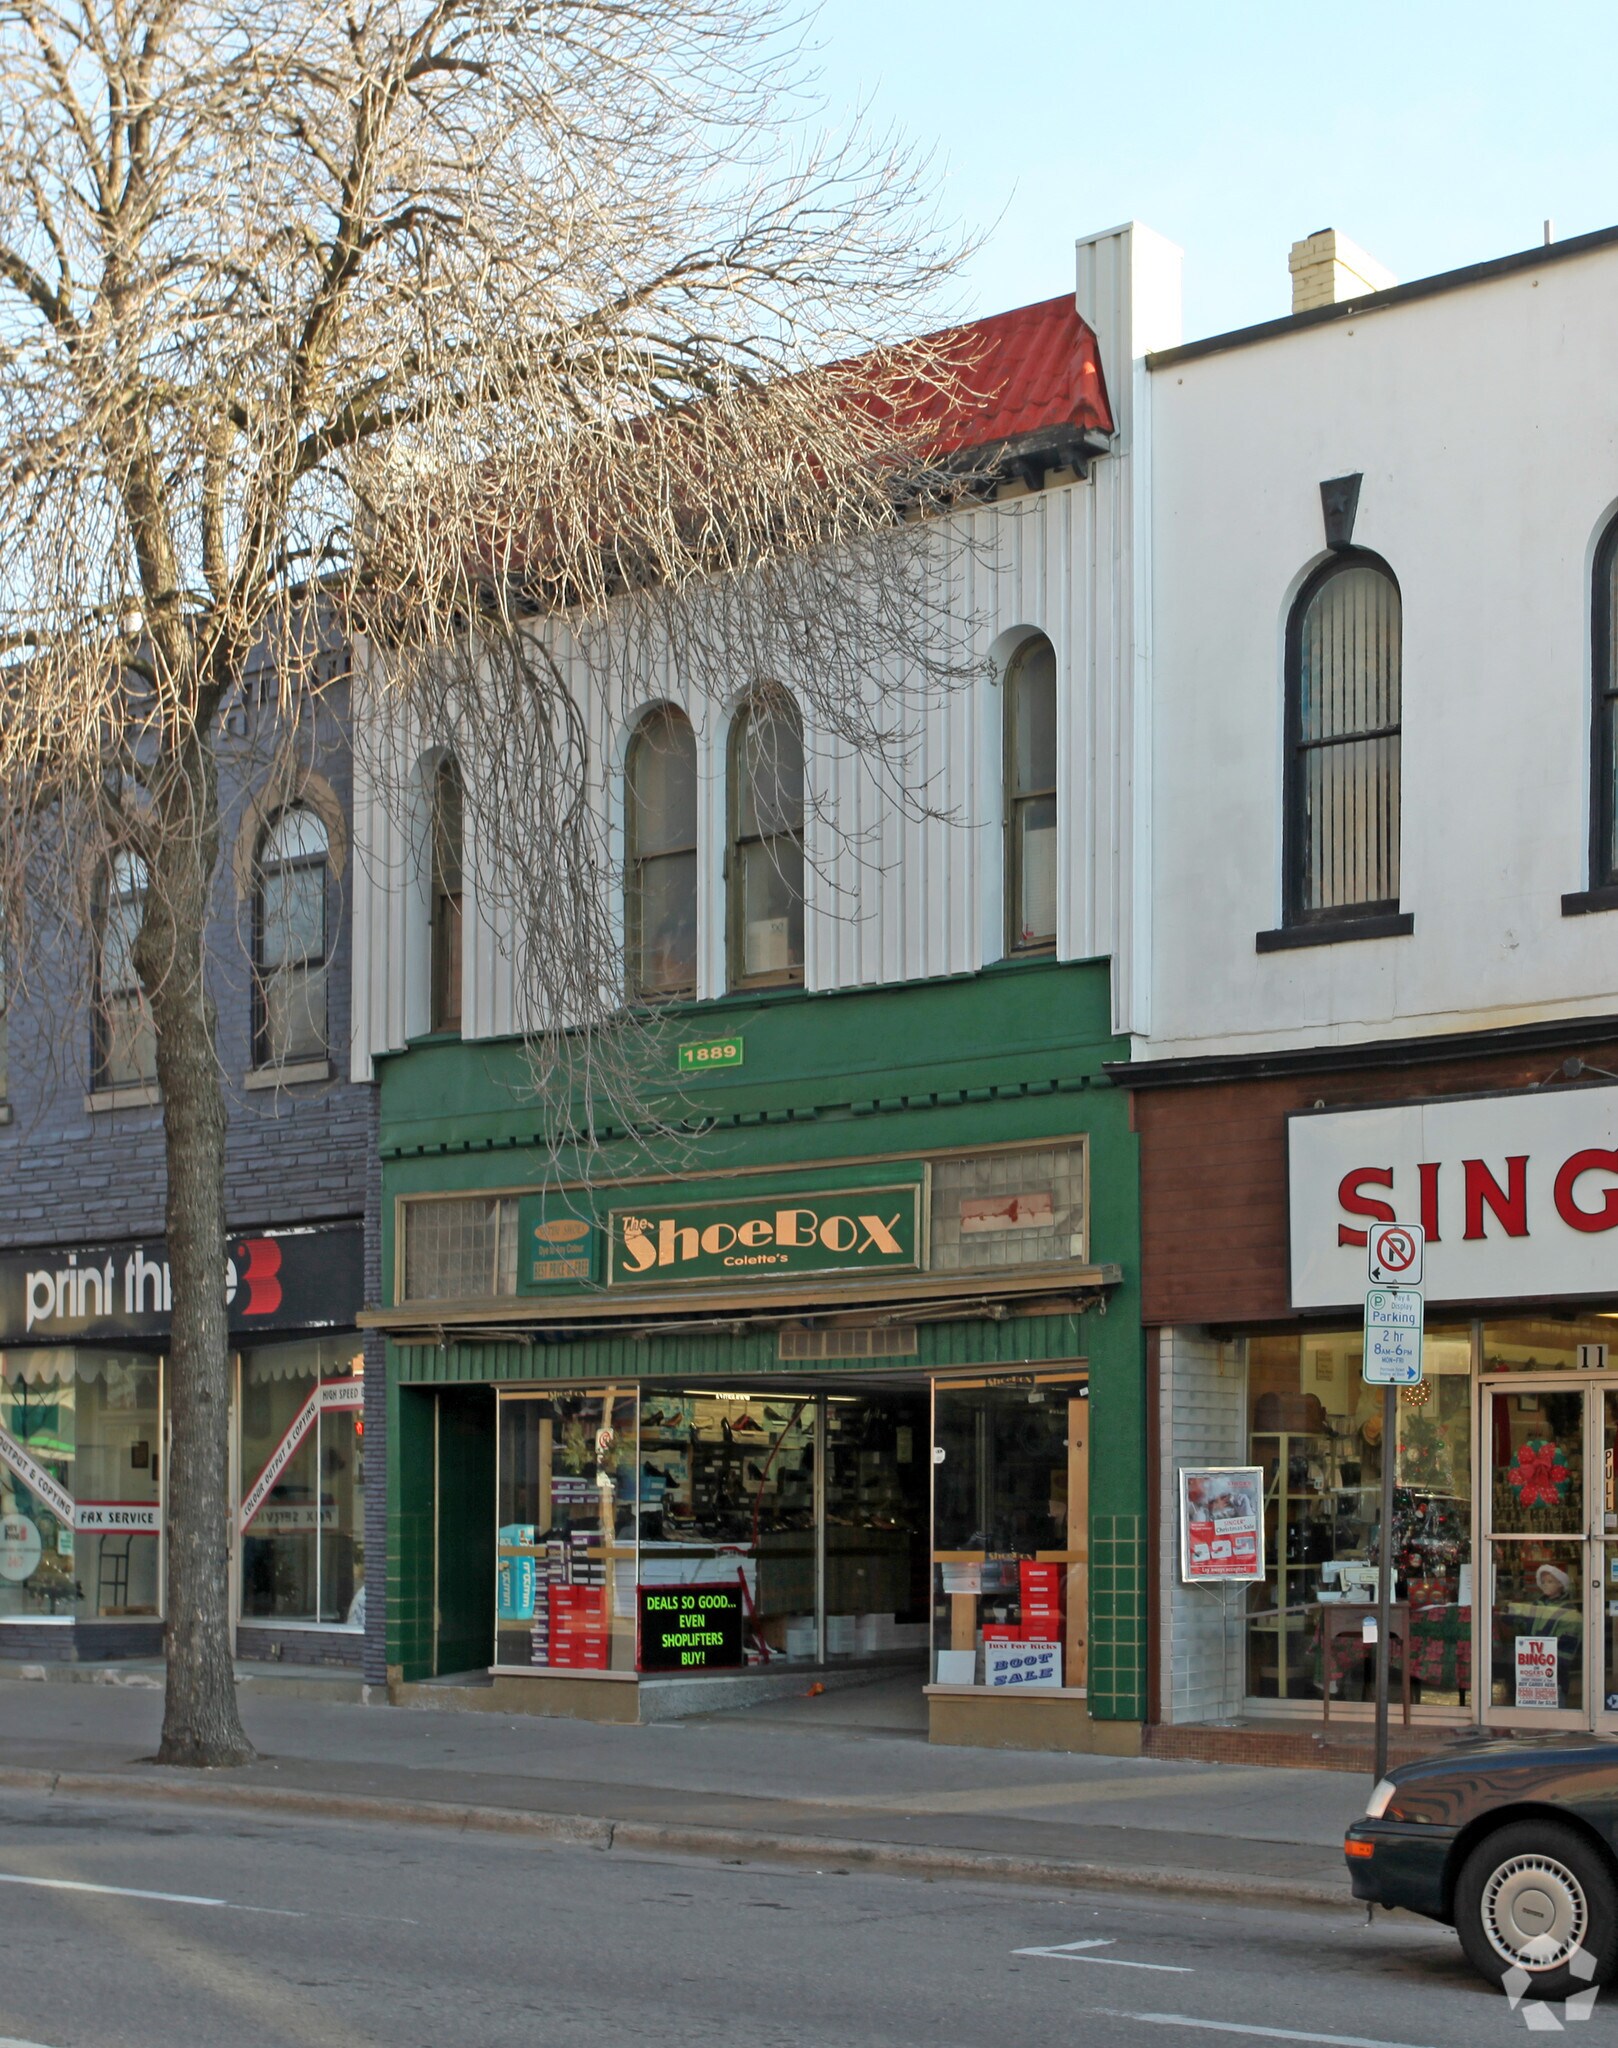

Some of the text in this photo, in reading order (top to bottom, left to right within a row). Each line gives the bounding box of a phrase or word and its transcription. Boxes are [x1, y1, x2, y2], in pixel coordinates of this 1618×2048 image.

[684, 1045, 736, 1063] 1889
[622, 1216, 647, 1232] The
[622, 1209, 904, 1273] ShoeBox
[724, 1253, 788, 1267] Colette's
[26, 1254, 115, 1333] print
[125, 1250, 237, 1315] thr
[1391, 1302, 1413, 1311] Display
[1373, 1311, 1415, 1326] Parking
[1383, 1329, 1404, 1342] 2 hr
[1581, 1346, 1604, 1368] 11
[322, 1391, 337, 1401] HIGH
[339, 1388, 358, 1399] SPEED
[244, 1483, 265, 1516] COLOUR
[264, 1449, 286, 1484] OUTPUT
[292, 1402, 316, 1440] COPYING
[1605, 1450, 1613, 1511] PULL
[29, 1470, 36, 1480] &
[38, 1477, 72, 1515] COPYING
[81, 1511, 154, 1524] FAX SERVICE
[1216, 1525, 1243, 1534] Christmas
[646, 1594, 737, 1611] DEALS SO GOOD...
[679, 1614, 705, 1628] EVEN
[661, 1631, 724, 1648] SHOPLIFTERS
[1529, 1641, 1544, 1654] TV
[681, 1651, 705, 1666] BUY!
[993, 1652, 1053, 1672] BOOT
[1518, 1653, 1555, 1666] BINGO
[993, 1667, 1054, 1687] SALE
